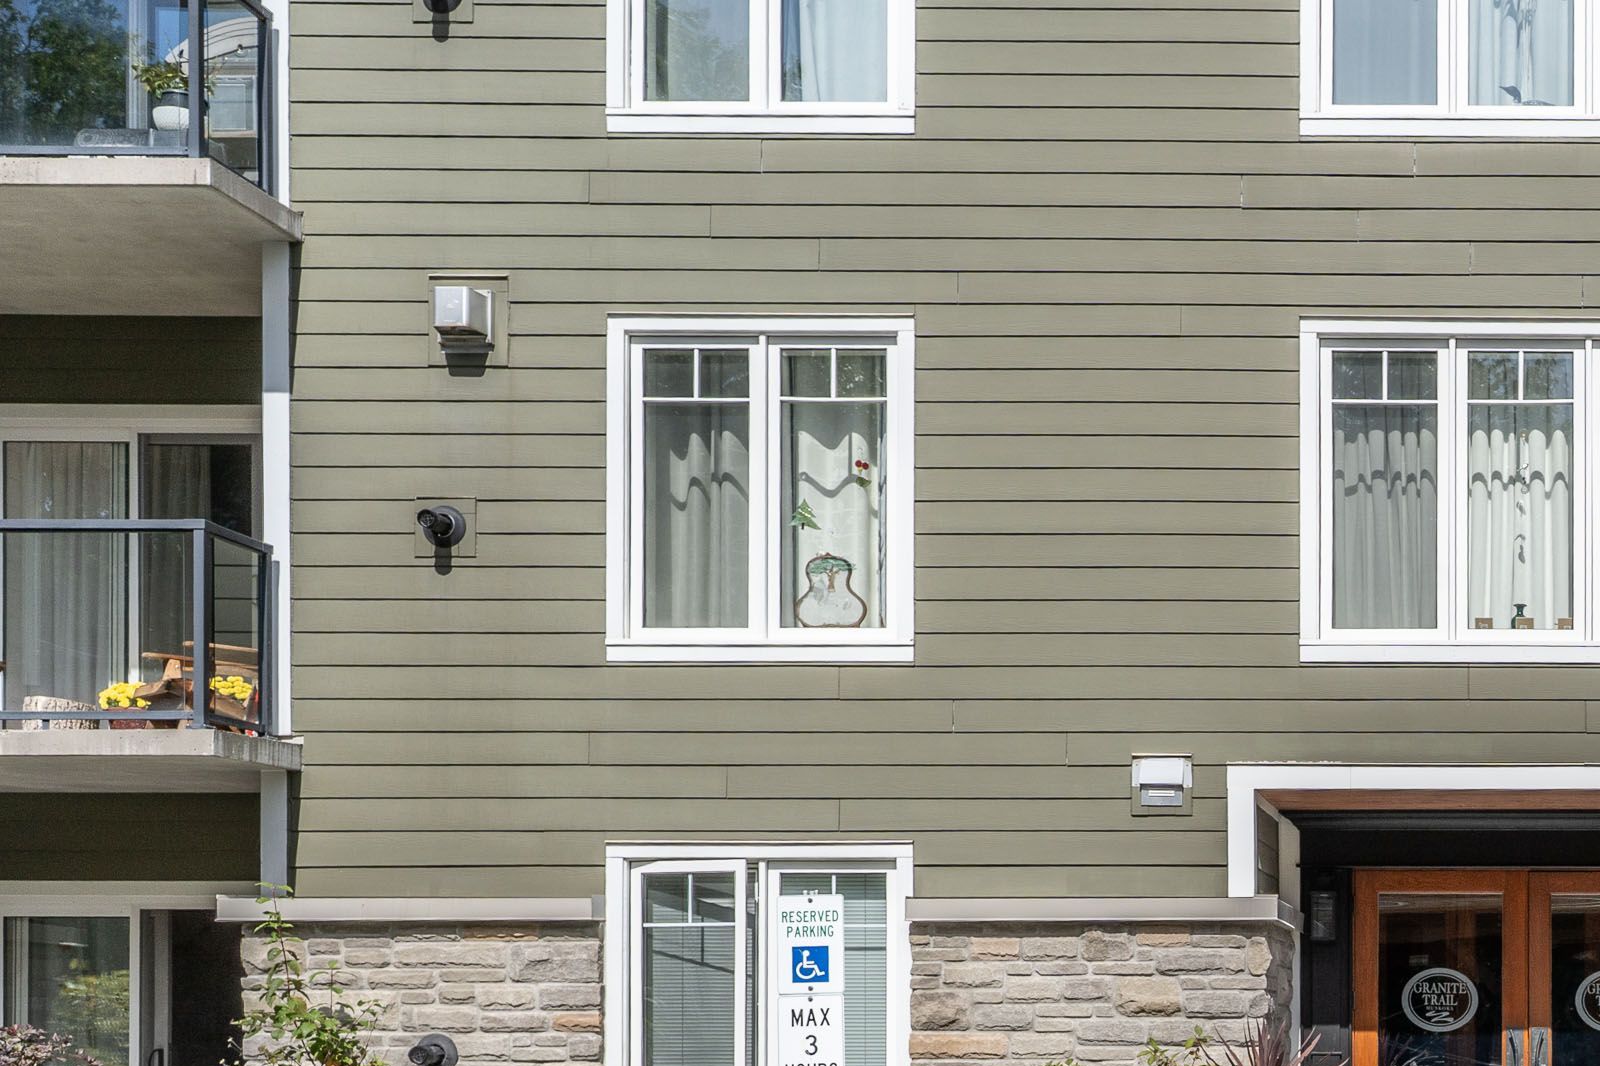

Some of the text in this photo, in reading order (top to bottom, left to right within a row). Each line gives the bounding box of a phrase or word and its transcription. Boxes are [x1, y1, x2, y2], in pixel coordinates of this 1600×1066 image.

[781, 910, 839, 923] RESERVED
[786, 925, 834, 938] PARKING
[1413, 982, 1467, 994] GRANITE
[1422, 994, 1458, 1006] TRAIL
[791, 1008, 830, 1027] MAX
[805, 1035, 818, 1056] 3
